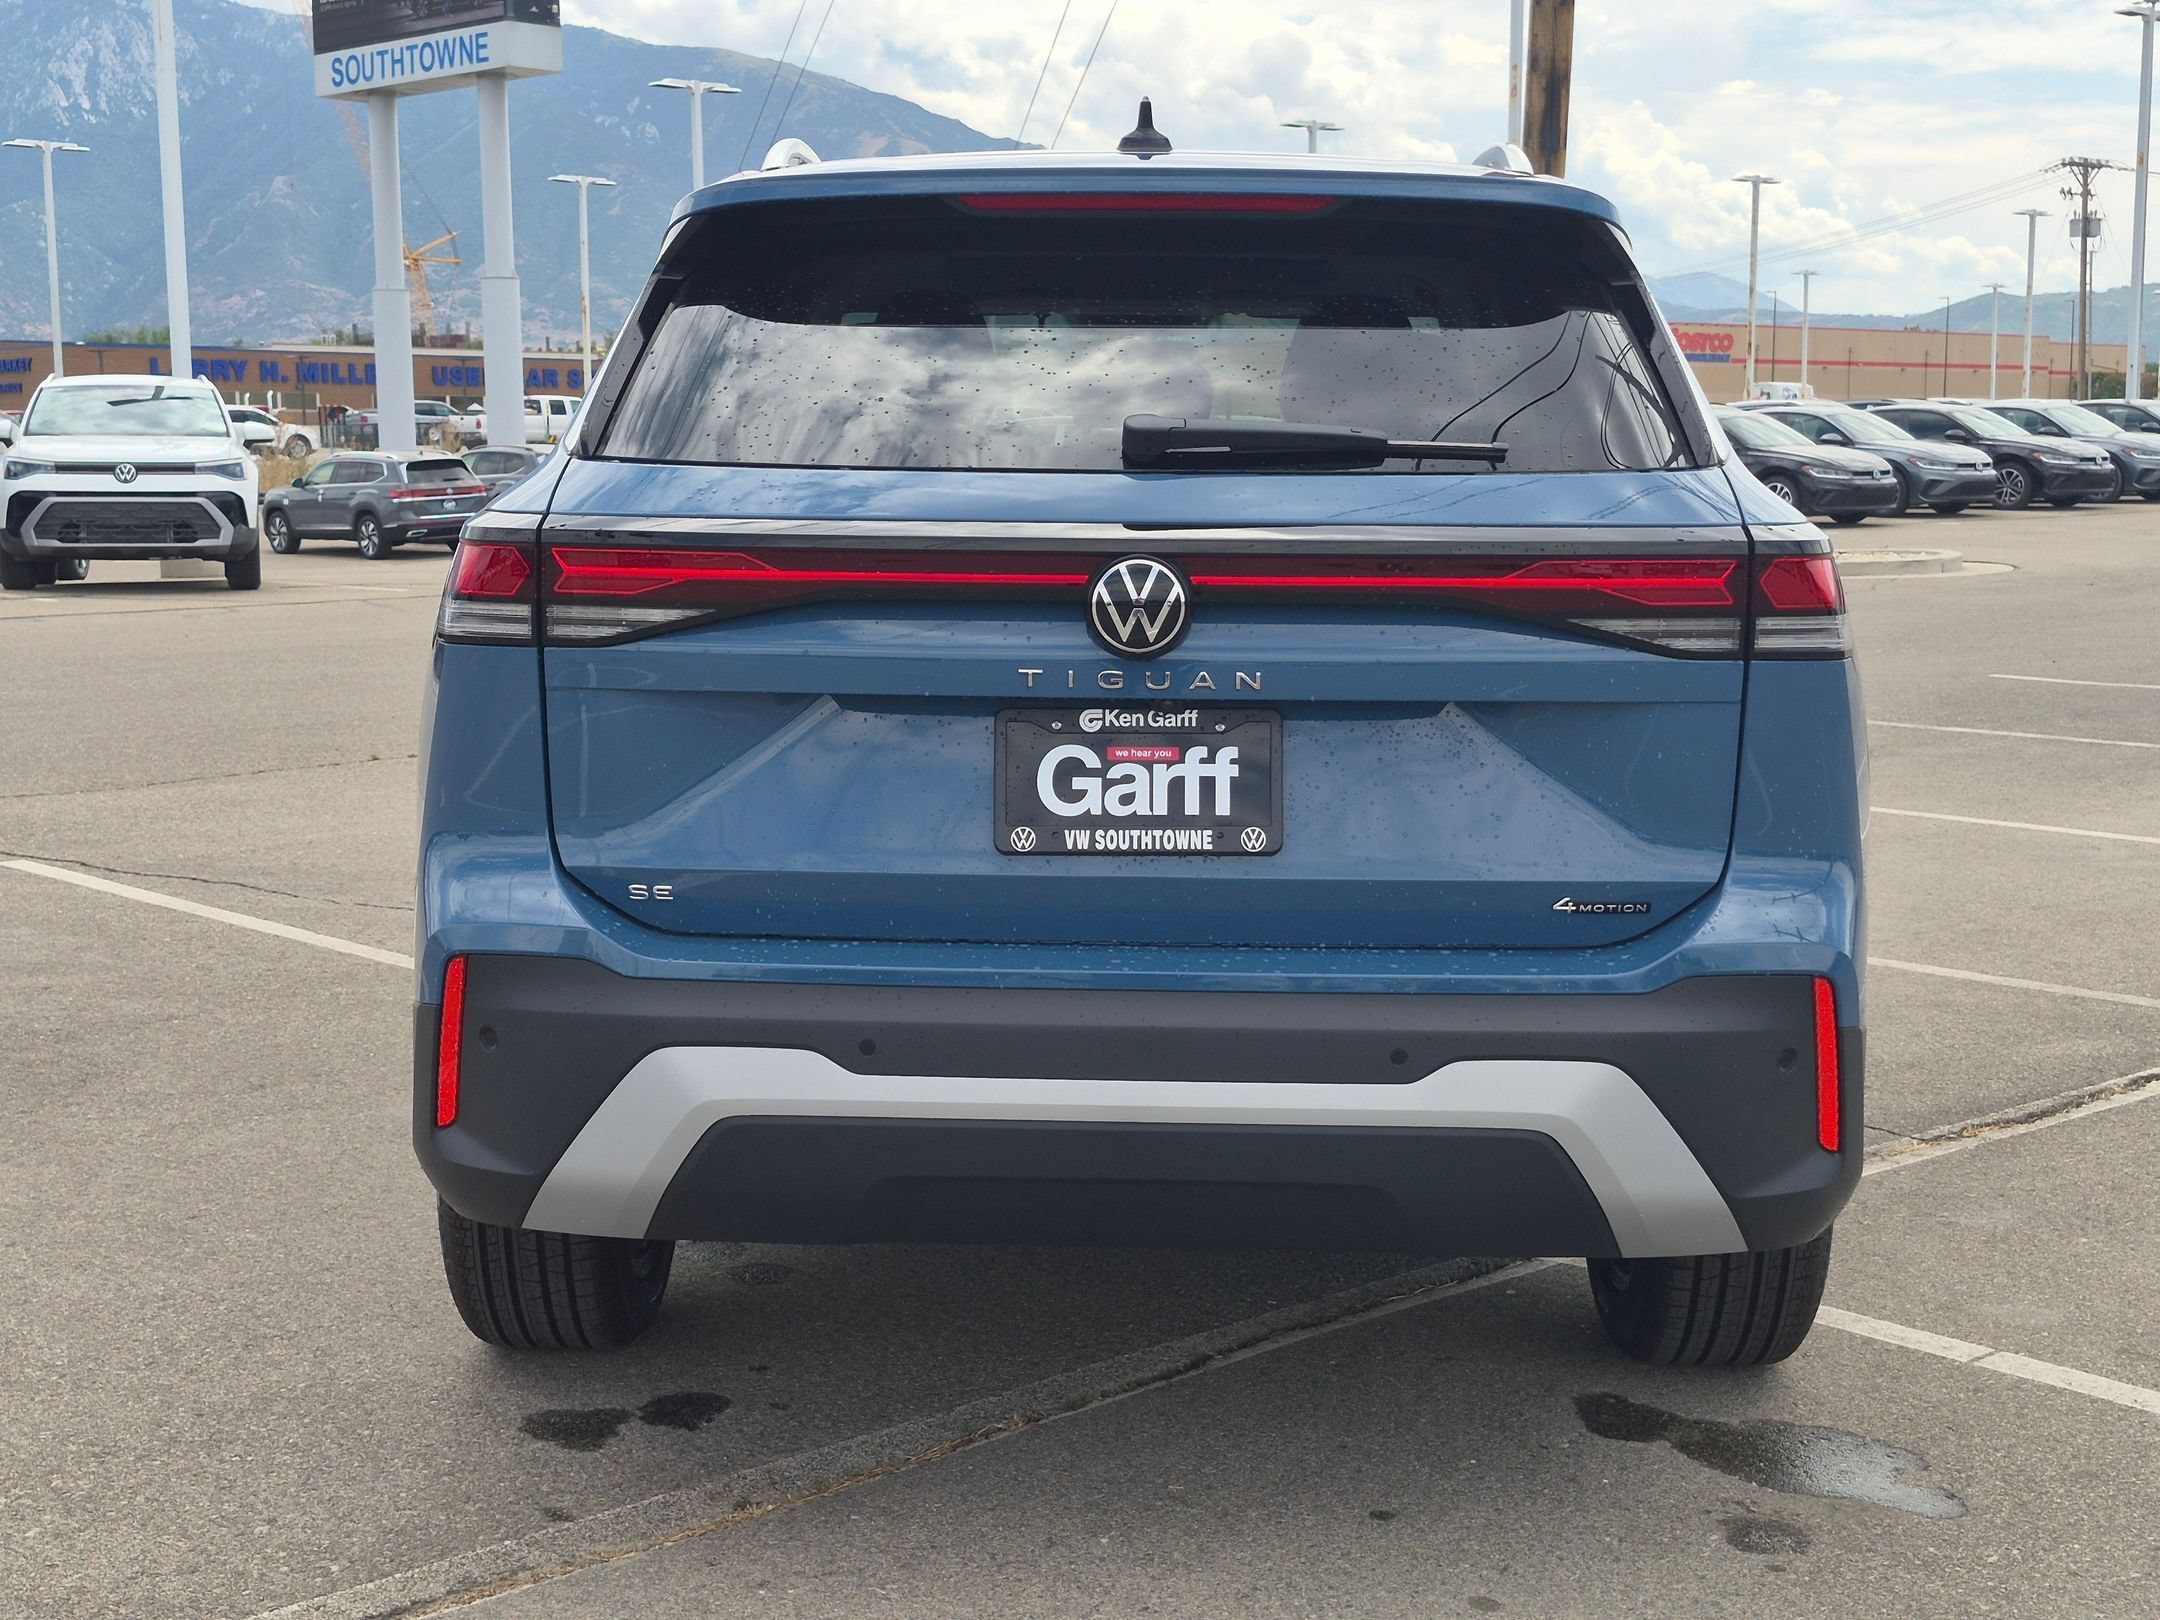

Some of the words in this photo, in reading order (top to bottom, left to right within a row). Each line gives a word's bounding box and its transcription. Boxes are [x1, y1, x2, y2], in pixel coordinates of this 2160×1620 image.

[331, 31, 489, 88] SOUTHTOWNE
[149, 357, 248, 382] LRRY
[259, 360, 288, 383] H.
[296, 362, 376, 384] MILLE
[432, 366, 485, 387] USE
[526, 368, 559, 389] AR
[1018, 668, 1262, 690] TIGUAN
[1105, 709, 1144, 727] Ken
[1147, 709, 1198, 727] Garff
[1131, 749, 1151, 757] hear
[1154, 750, 1172, 759] you
[1037, 744, 1239, 817] Garff
[1064, 829, 1090, 850] VW
[1095, 829, 1213, 850] SOUTHTOWNE
[628, 884, 674, 900] SE
[1552, 897, 1647, 914] 4MOTION
